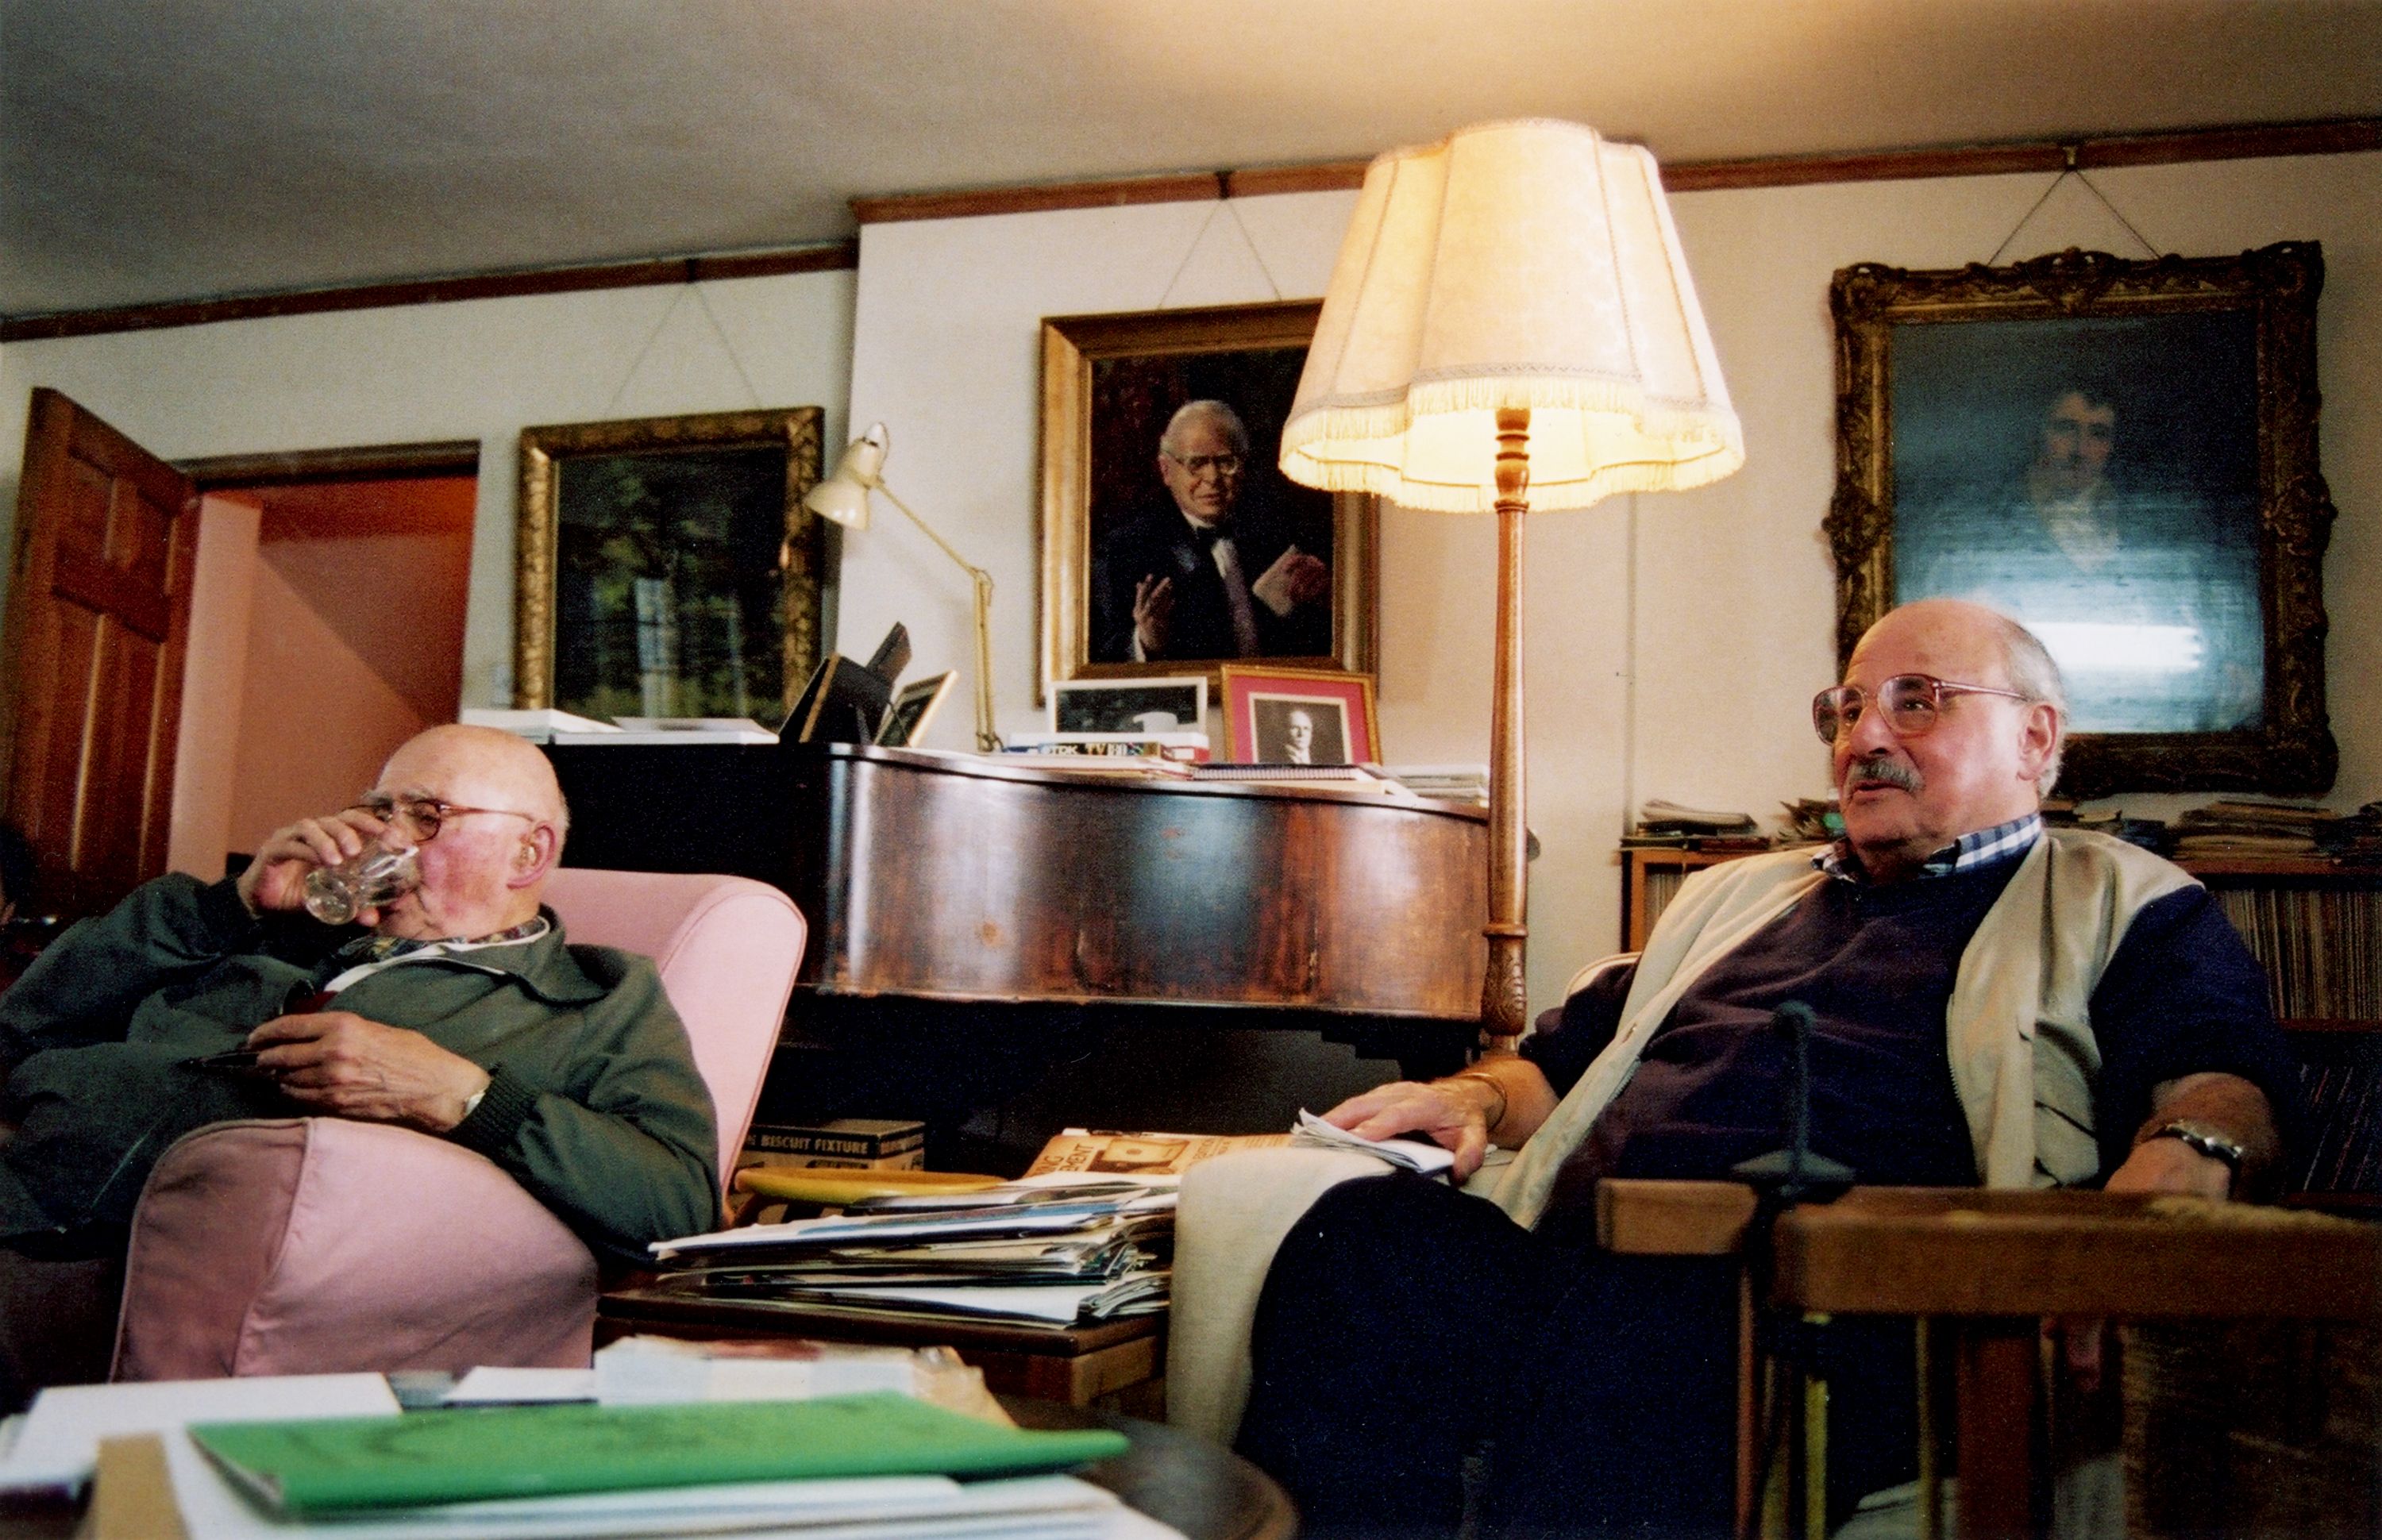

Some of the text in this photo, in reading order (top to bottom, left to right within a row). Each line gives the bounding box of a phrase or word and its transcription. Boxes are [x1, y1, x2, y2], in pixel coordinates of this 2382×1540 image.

[1050, 745, 1080, 755] TDK
[1086, 743, 1107, 756] TV
[761, 1134, 811, 1150] BISCUIT
[815, 1138, 869, 1154] FIXTURE
